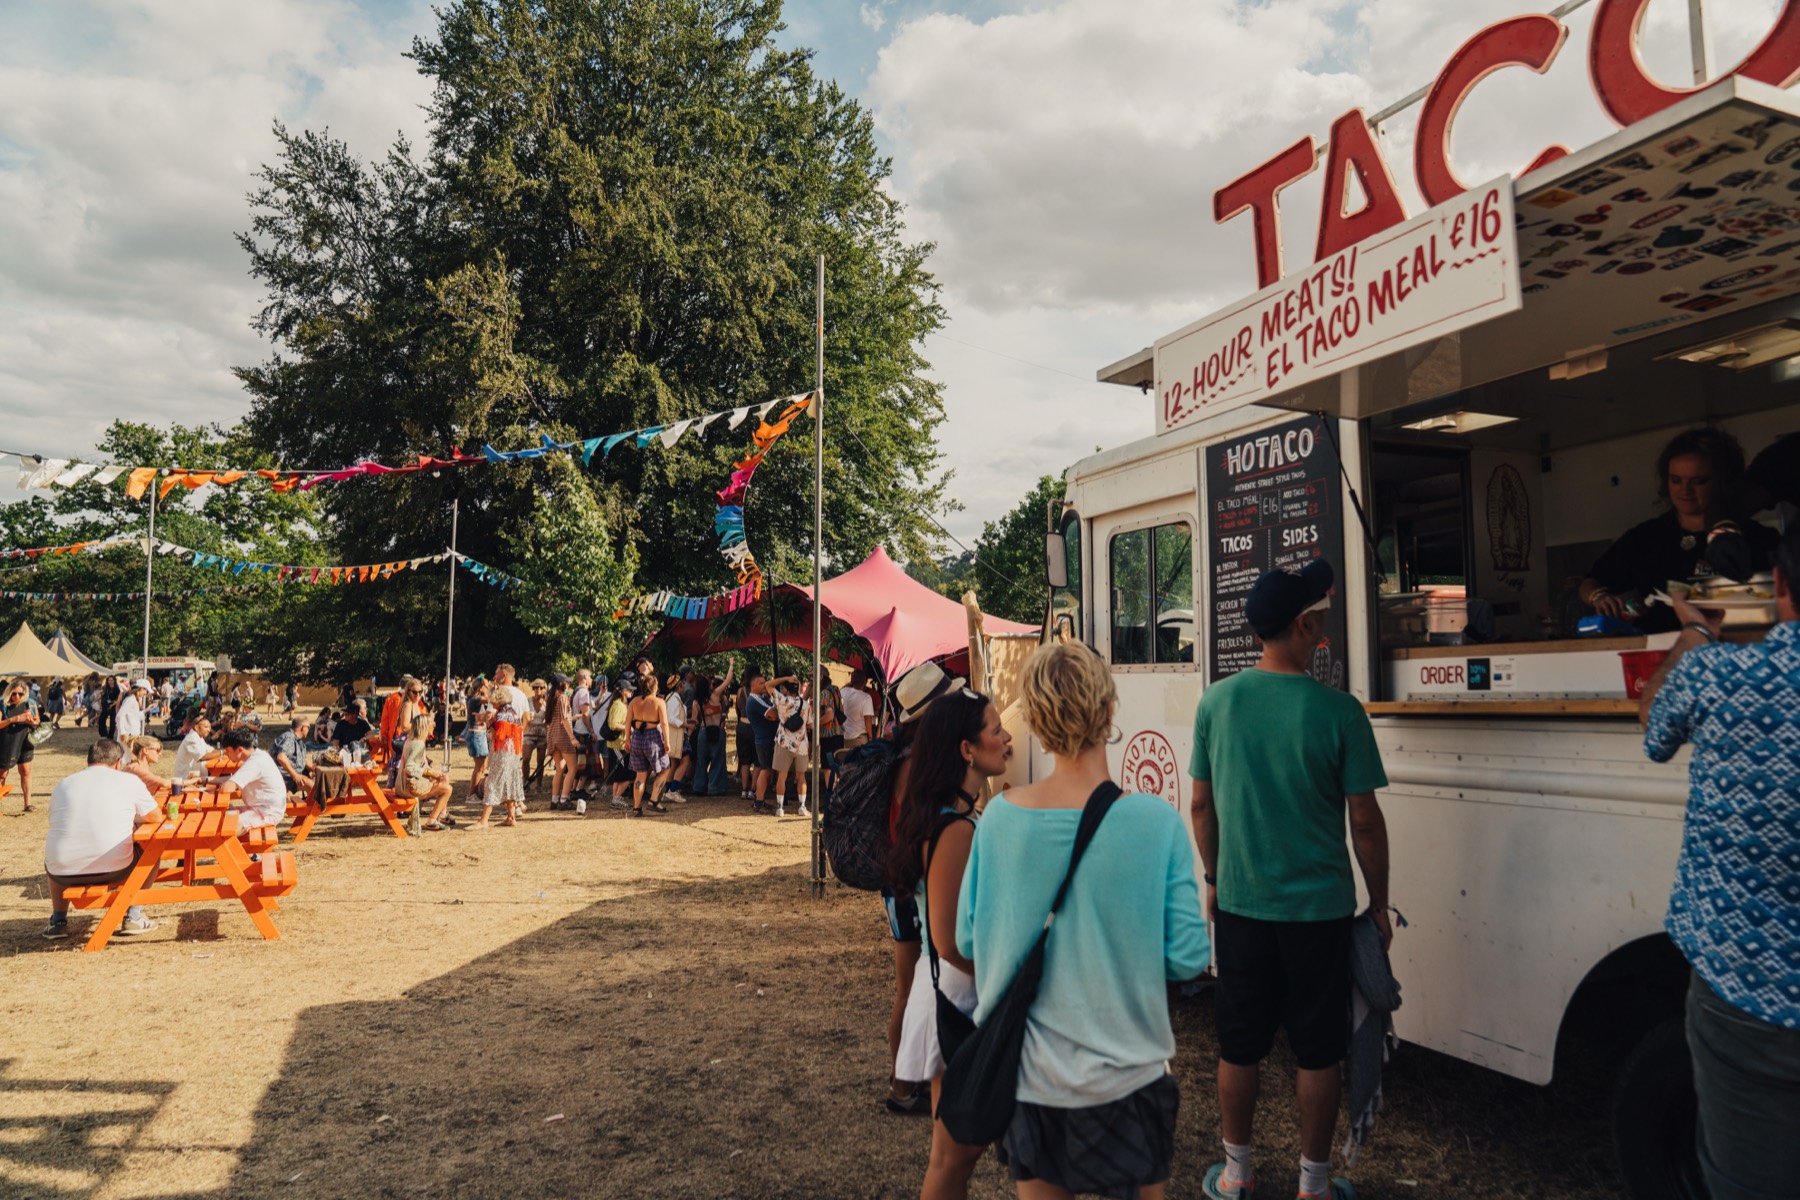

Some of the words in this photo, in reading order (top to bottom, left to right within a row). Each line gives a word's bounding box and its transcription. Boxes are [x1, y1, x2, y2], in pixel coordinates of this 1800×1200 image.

[1267, 342, 1294, 390] EL
[1295, 296, 1360, 365] TACO
[1368, 234, 1446, 326] MEAL
[1449, 188, 1501, 250] £16
[1164, 325, 1253, 422] 12-HOUR
[1260, 246, 1358, 348] MEATS!
[1226, 428, 1314, 476] HOTACO
[1258, 477, 1274, 488] STREET
[1275, 473, 1290, 484] STYLE
[1291, 470, 1306, 480] TACOS
[1293, 488, 1305, 497] TACO
[1217, 501, 1225, 511] EL
[1226, 498, 1240, 509] TACO
[1243, 494, 1259, 506] MEAL
[1221, 534, 1253, 554] TACOS
[1282, 524, 1319, 547] SIDES
[1275, 554, 1294, 566] SINGLE
[1296, 550, 1309, 559] TACO
[1216, 599, 1238, 612] CHICKEN
[1217, 636, 1244, 650] FRIJOLES
[1420, 665, 1465, 685] ORDER
[1469, 664, 1487, 674] 10%
[1469, 674, 1481, 684] off
[1126, 737, 1174, 776] HOTACO
